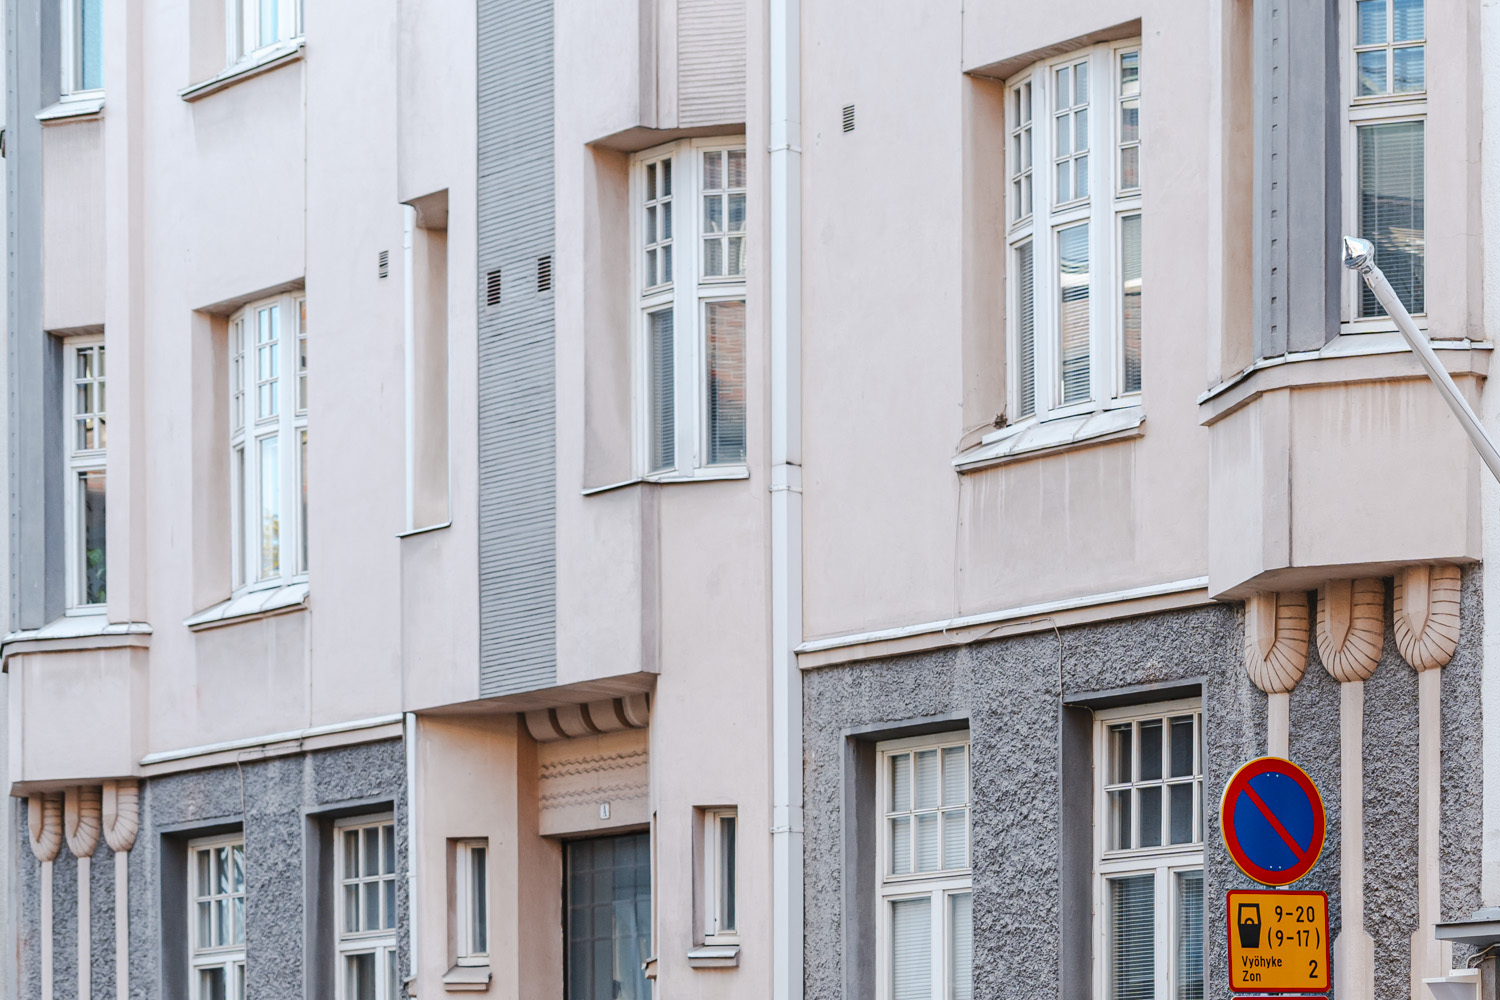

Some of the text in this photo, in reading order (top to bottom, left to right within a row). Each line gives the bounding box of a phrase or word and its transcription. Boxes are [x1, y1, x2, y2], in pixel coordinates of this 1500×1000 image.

[1275, 905, 1315, 923] 9-20
[1268, 927, 1320, 950] (9-17)
[1241, 955, 1283, 969] Vyöhyke
[1309, 960, 1318, 979] 2
[1242, 970, 1262, 982] Zon
